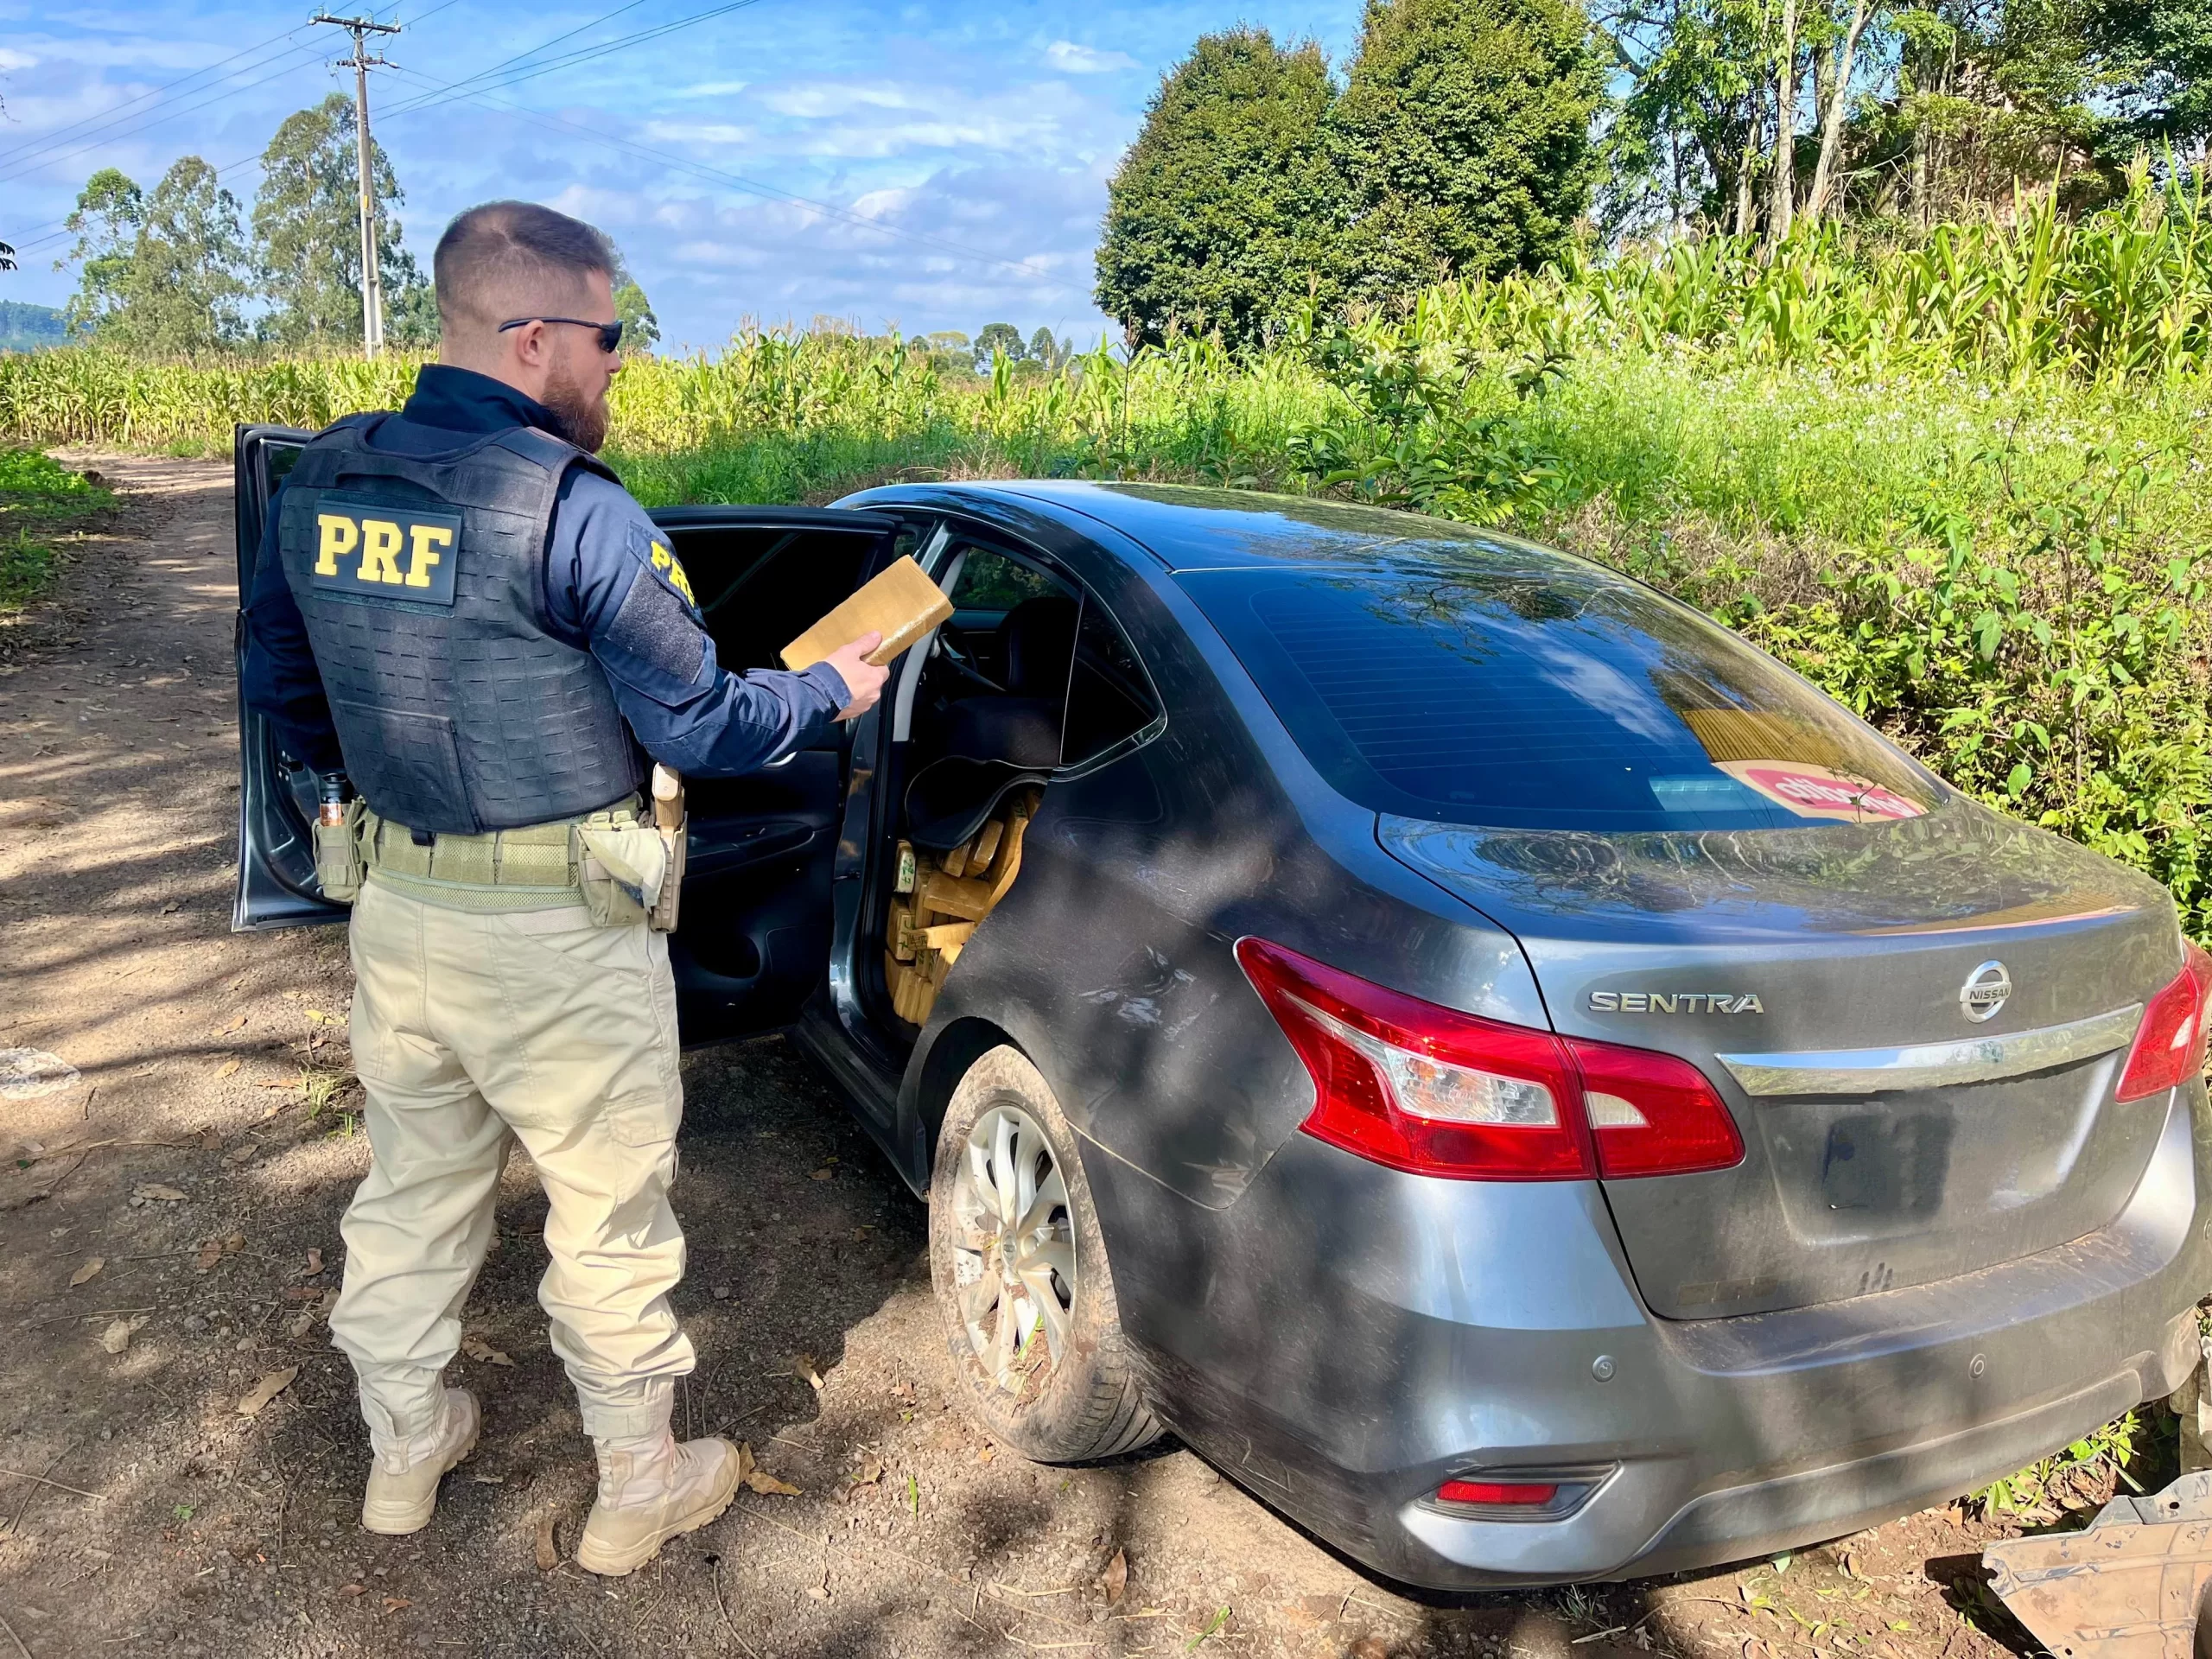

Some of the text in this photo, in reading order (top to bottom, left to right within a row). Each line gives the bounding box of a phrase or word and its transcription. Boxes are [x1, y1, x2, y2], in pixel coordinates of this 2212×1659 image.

[314, 513, 453, 588] PRF
[1588, 991, 1764, 1014] SENTRA
[1969, 988, 2009, 1000] NISSAN
